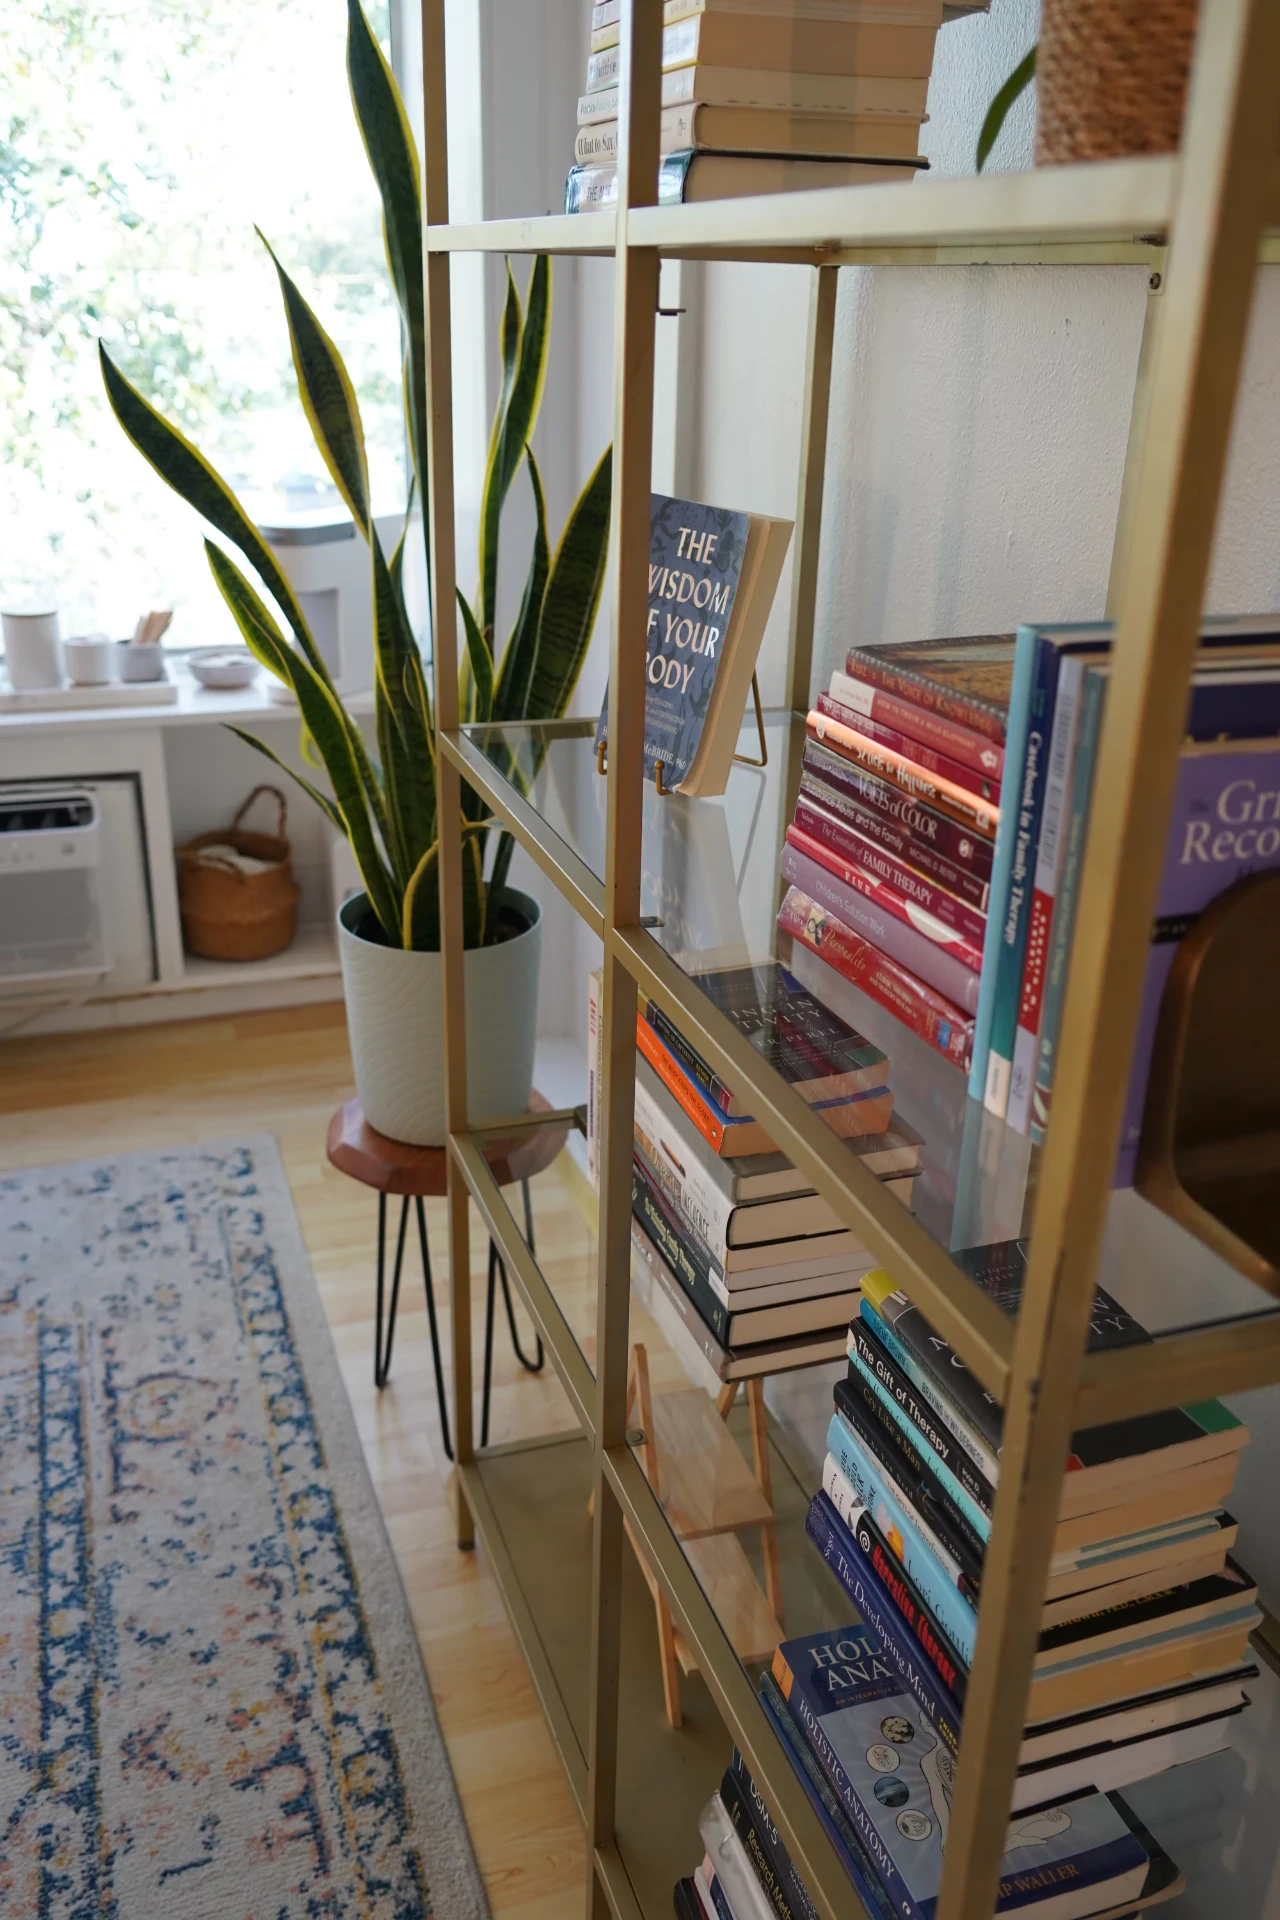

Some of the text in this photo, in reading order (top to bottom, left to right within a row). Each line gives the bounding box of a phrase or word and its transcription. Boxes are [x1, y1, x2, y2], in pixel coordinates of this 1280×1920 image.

[578, 137, 594, 155] What
[595, 138, 601, 153] to
[676, 526, 718, 565] THE
[647, 608, 719, 659] F YOUR
[805, 780, 838, 808] Substance
[836, 797, 856, 820] Abuse
[855, 811, 869, 829] and
[868, 820, 882, 837] the
[880, 825, 904, 851] Family
[859, 776, 891, 814] VOICES
[889, 801, 901, 818] of
[900, 801, 938, 840] COLOR
[822, 823, 832, 838] The
[831, 829, 857, 853] Essentials
[863, 851, 893, 880] FAMILY
[893, 869, 933, 905] THERAPY
[844, 870, 871, 896] FIVE
[815, 881, 844, 909] Children's
[843, 899, 871, 926] Solution
[1003, 885, 1025, 947] Therapy
[823, 928, 867, 980] Personality
[668, 1063, 678, 1082] BODY
[678, 1076, 689, 1096] KEEPS
[689, 1092, 697, 1108] THE
[697, 1102, 710, 1123] SCORE
[680, 1183, 710, 1243] INFLUENCE
[975, 1263, 1019, 1278] ATIONAL
[858, 1335, 950, 1459] The Gift of Therapy
[921, 1382, 944, 1416] BRAVING
[950, 1416, 985, 1469] WILDERNESS
[842, 1404, 850, 1416] As
[852, 1415, 868, 1441] Long
[870, 1440, 879, 1453] As
[881, 1453, 893, 1474] You
[896, 1473, 914, 1500] Need
[863, 1387, 921, 1472] Cry Like a Man
[887, 1481, 951, 1572] THE GIFTS OF Imperfection
[943, 1498, 984, 1554] JASON WILSON
[837, 1551, 936, 1718] The Developing Mind
[872, 1544, 956, 1690] Narrative Therapy
[935, 1603, 972, 1667] Gottli
[939, 1716, 957, 1745] THIRD
[799, 1698, 895, 1878] HOLISTIC ANATOMY
[747, 1828, 774, 1888] Research
[1013, 1863, 1080, 1892] WALLER
